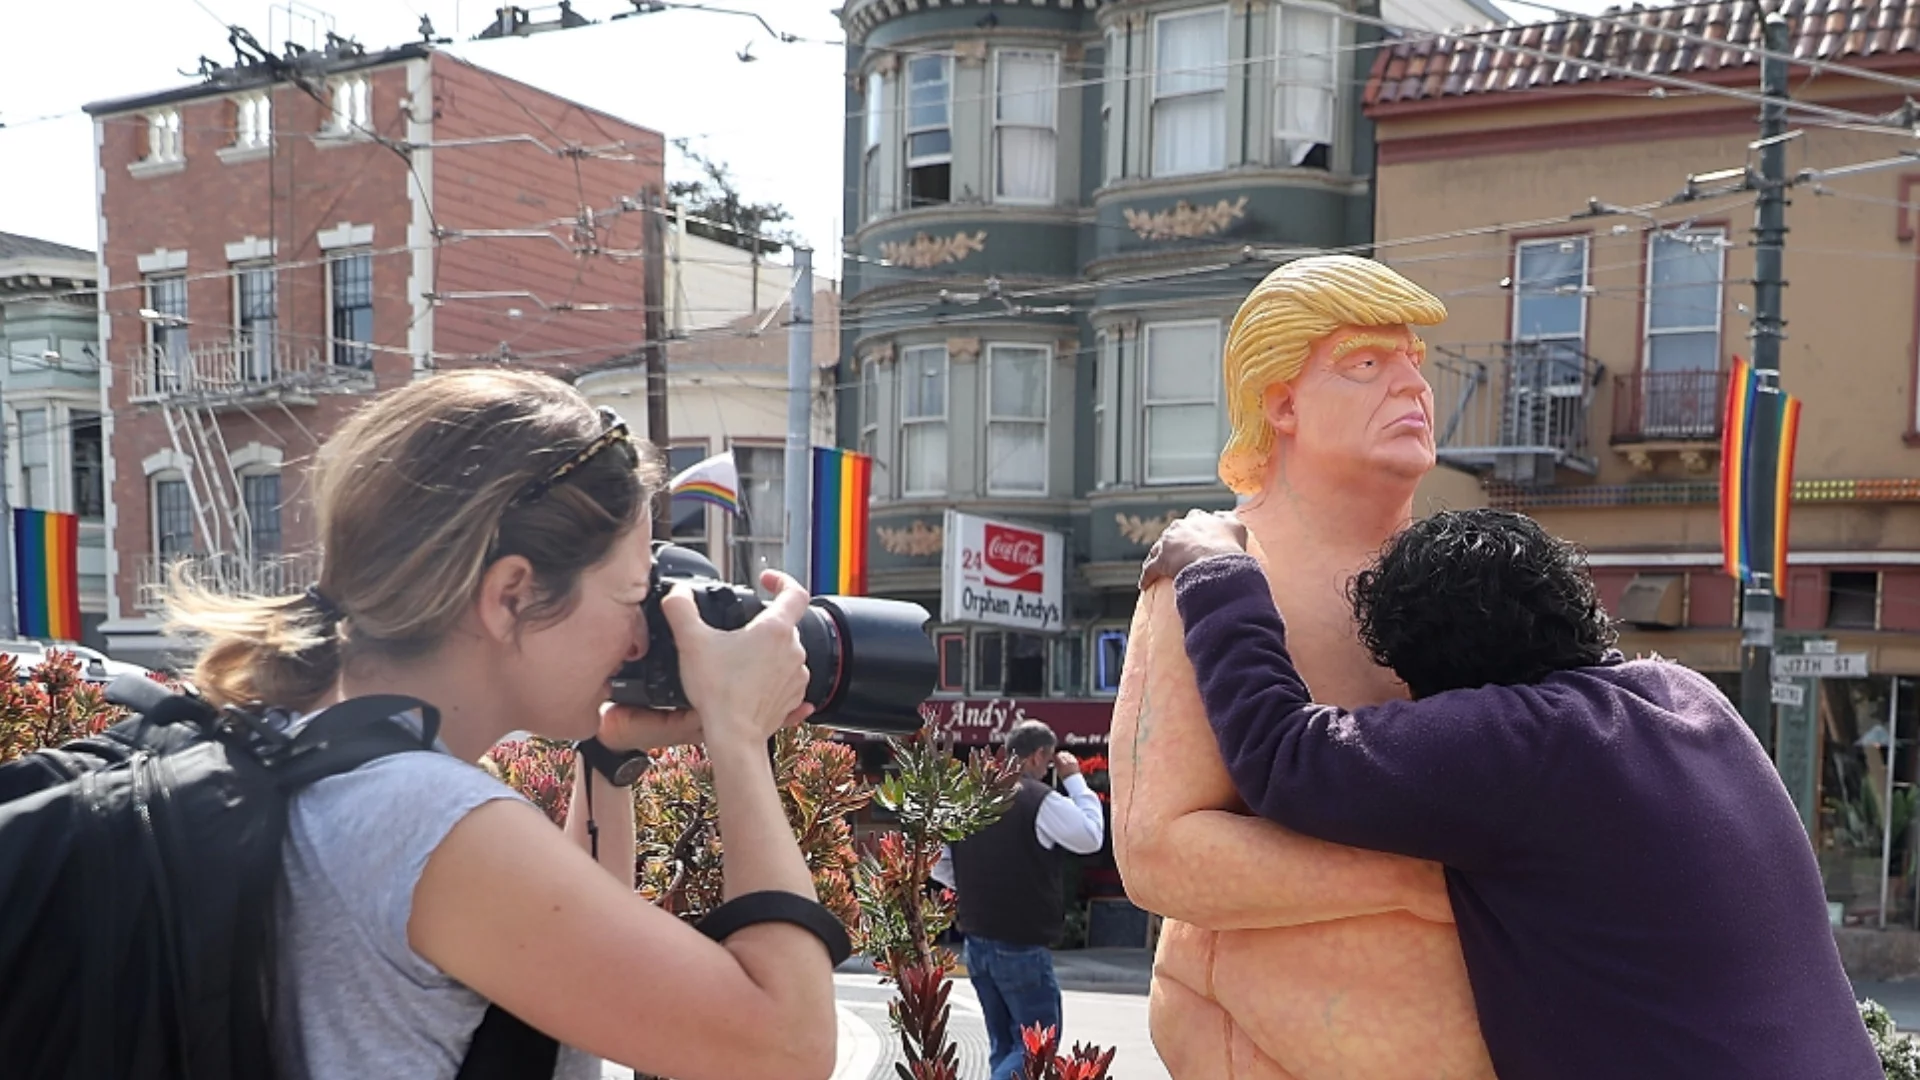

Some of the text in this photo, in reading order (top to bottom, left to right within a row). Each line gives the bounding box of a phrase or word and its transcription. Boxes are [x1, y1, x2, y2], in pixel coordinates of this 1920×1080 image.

[962, 548, 982, 570] 24
[962, 586, 1059, 628] Orphan Andy's
[1834, 658, 1850, 672] ST
[944, 698, 1025, 733] Andy's
